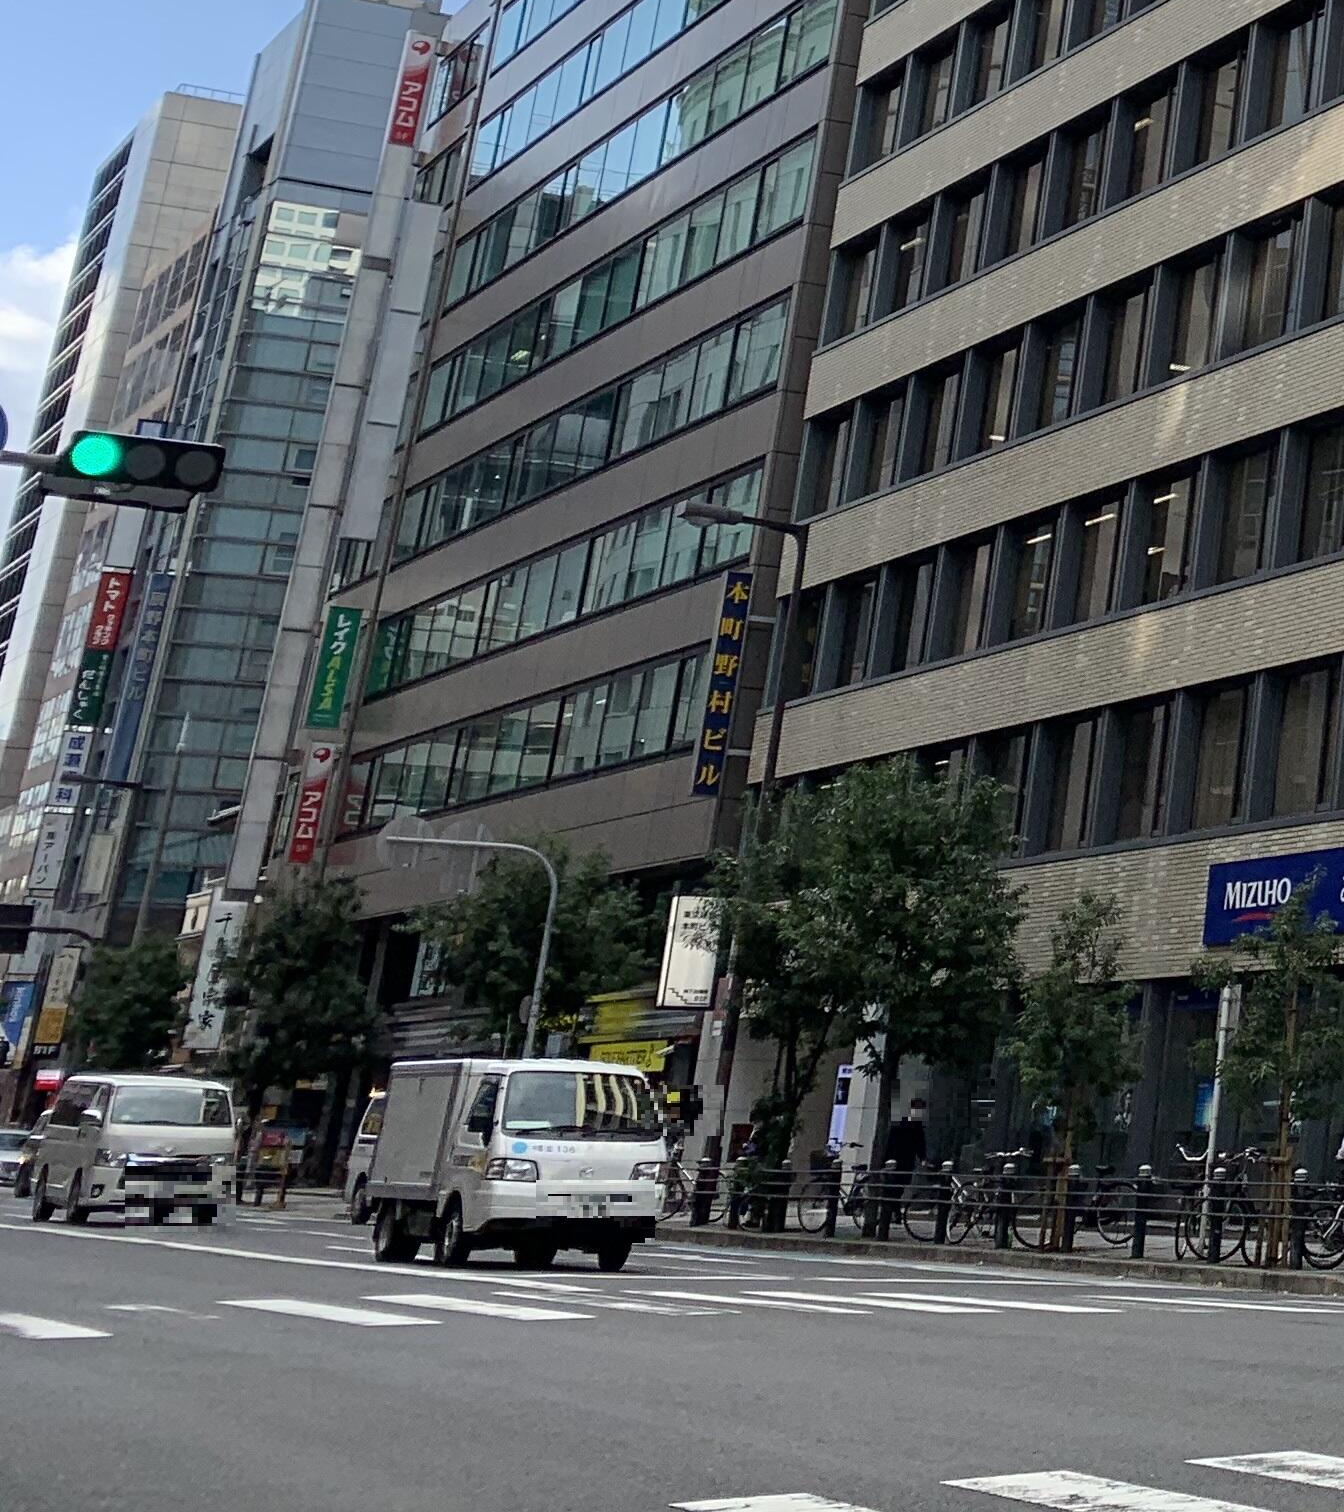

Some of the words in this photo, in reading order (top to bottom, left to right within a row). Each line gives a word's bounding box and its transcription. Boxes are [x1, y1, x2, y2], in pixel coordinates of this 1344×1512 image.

[395, 80, 422, 128] アコム
[696, 581, 750, 786] 本町野村ビル
[296, 791, 322, 839] アコム
[1223, 877, 1292, 911] MIZUHO
